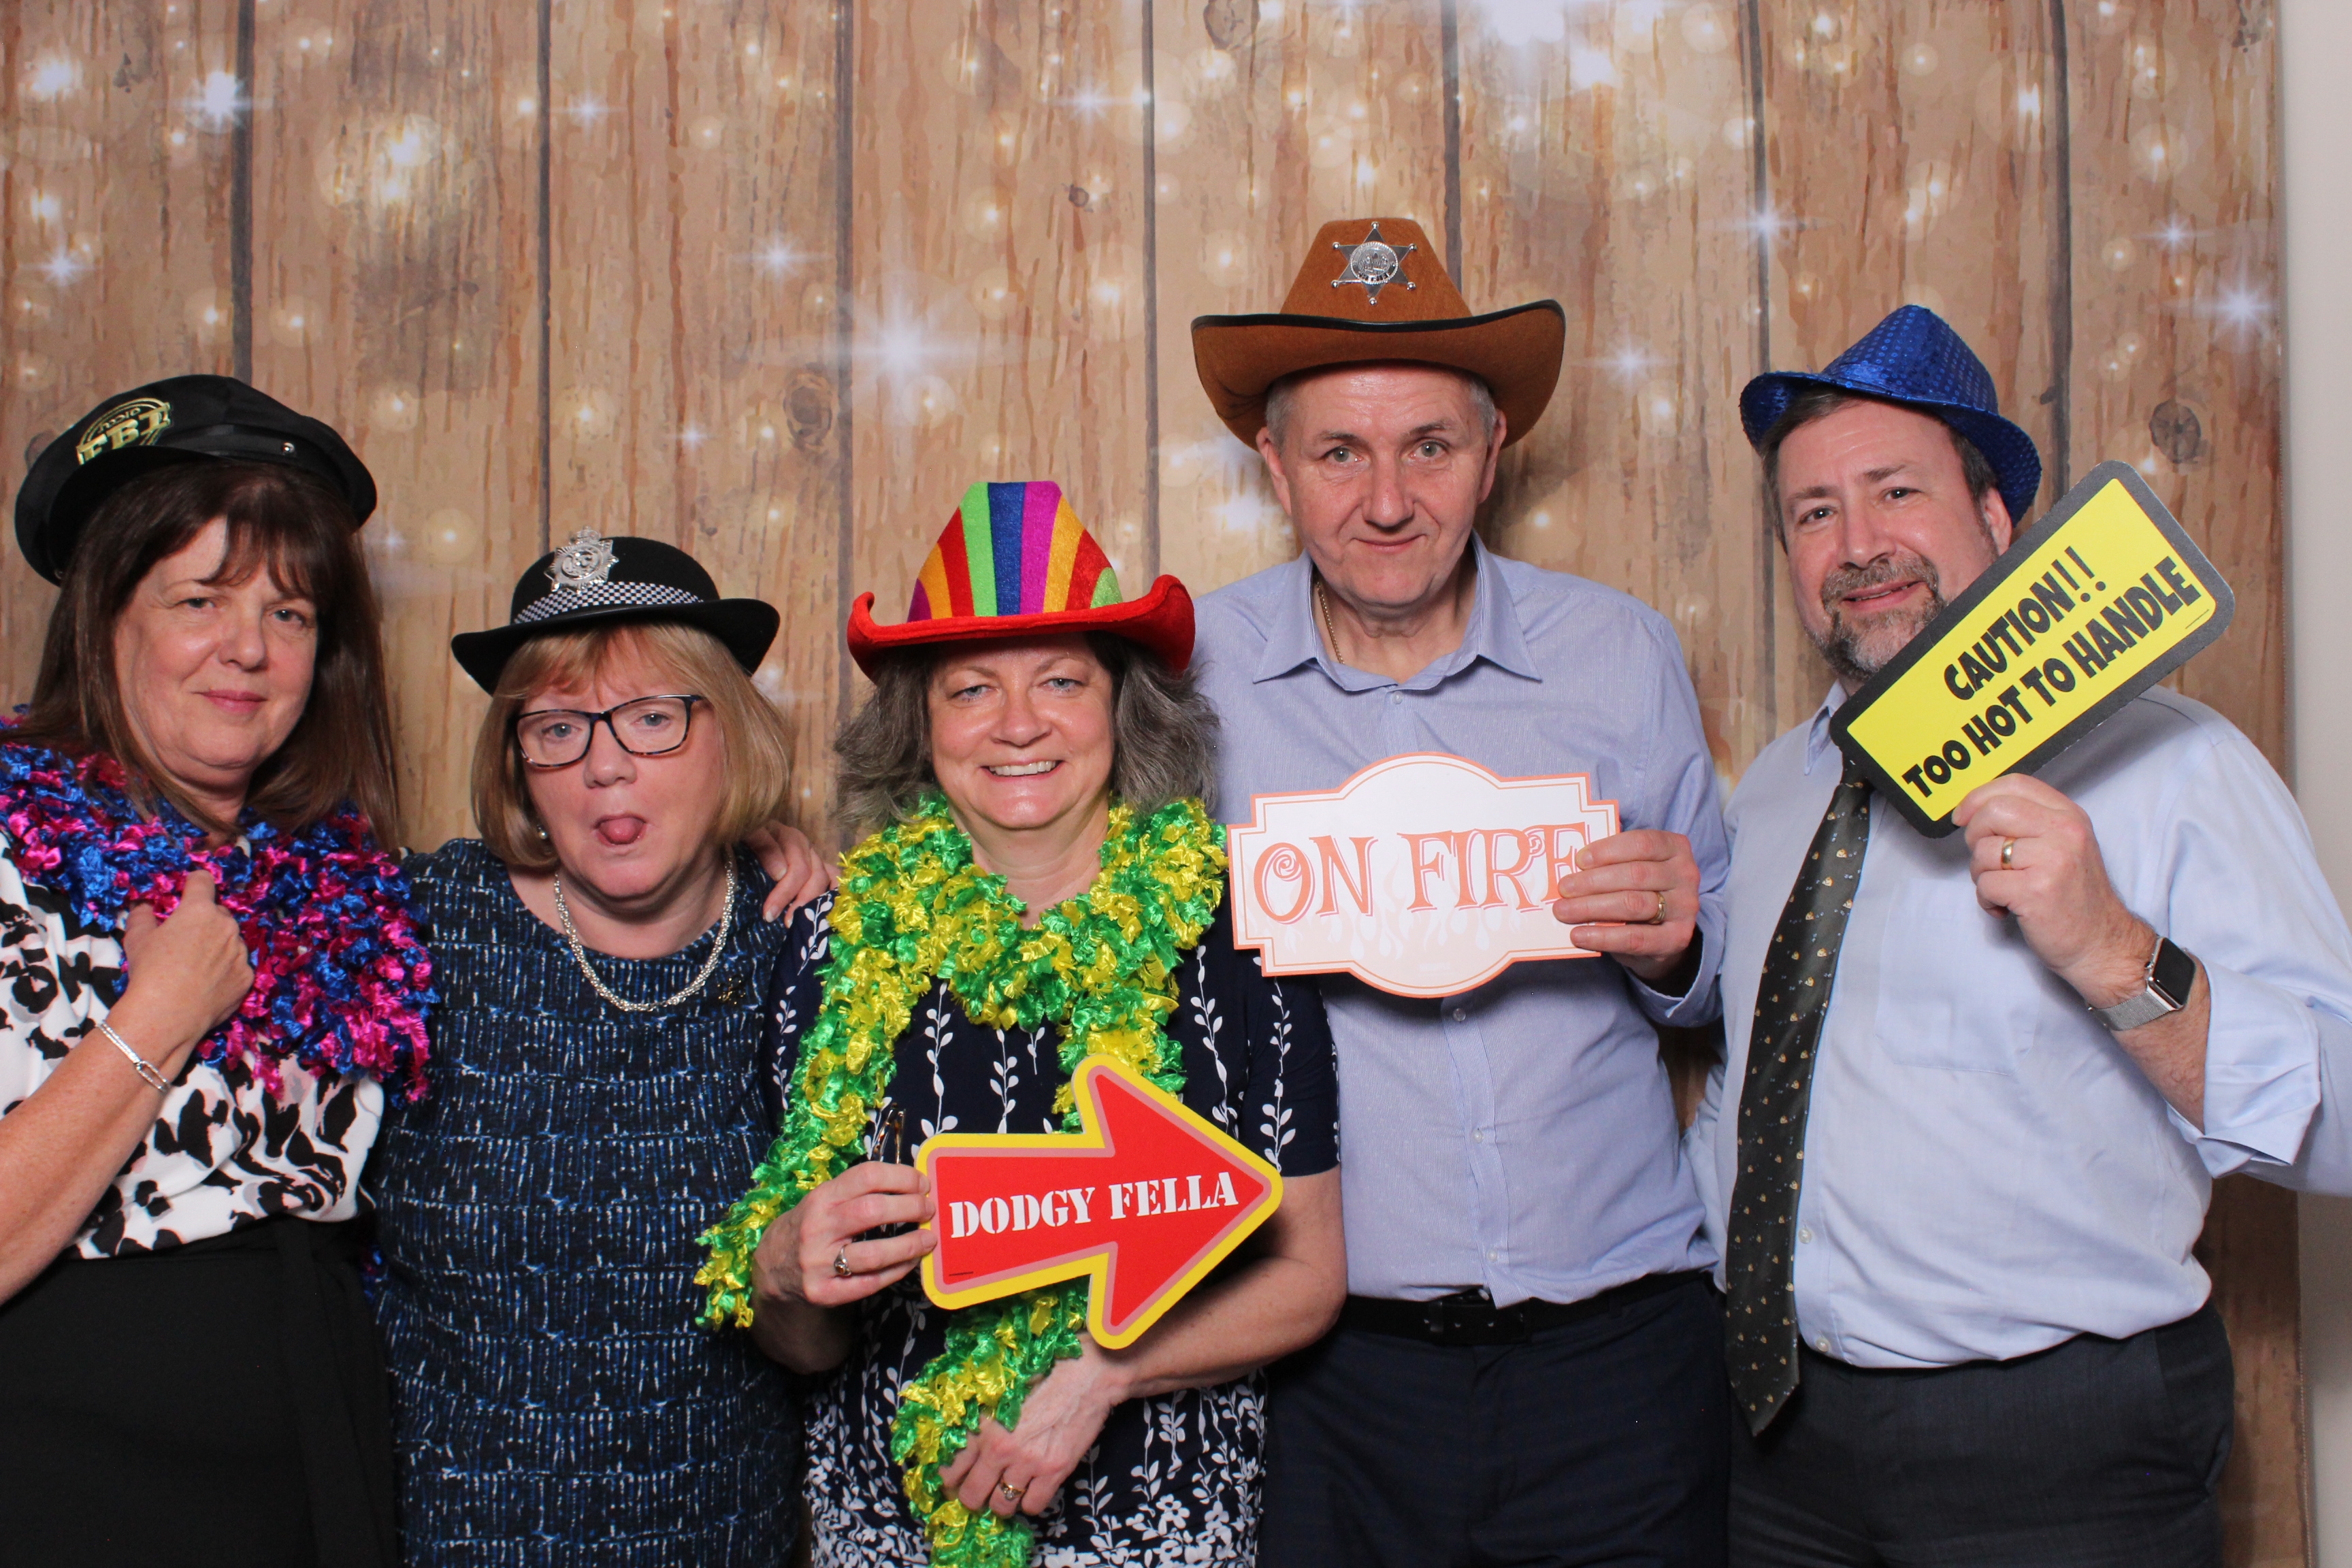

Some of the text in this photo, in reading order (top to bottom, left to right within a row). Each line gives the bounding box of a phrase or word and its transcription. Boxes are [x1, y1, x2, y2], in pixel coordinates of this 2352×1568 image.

[76, 402, 172, 466] FBI
[1943, 546, 2106, 700] CAUTION!!
[1901, 556, 2201, 798] TOO HOT TO HANDLE
[1253, 821, 1591, 925] ON FIRE
[949, 1171, 1239, 1239] DODGY FELLA
